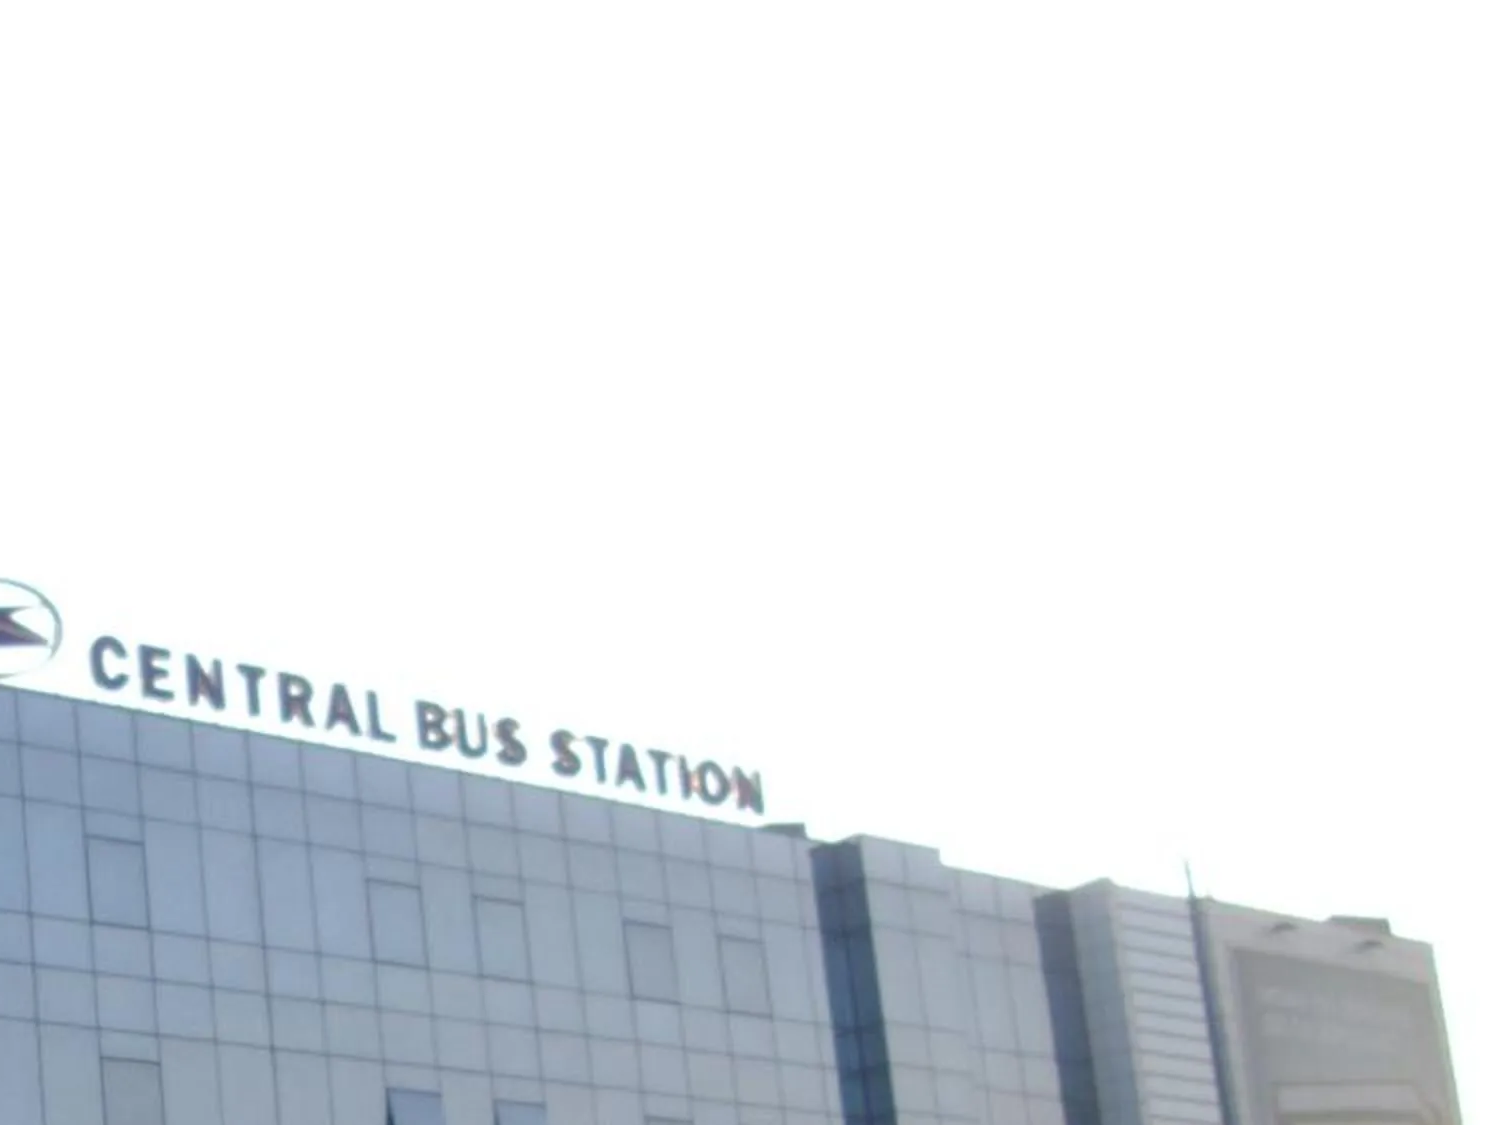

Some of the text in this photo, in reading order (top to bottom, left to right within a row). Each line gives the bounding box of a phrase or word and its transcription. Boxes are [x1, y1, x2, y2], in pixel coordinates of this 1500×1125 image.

[89, 636, 766, 814] CENTRAL BUS STATION
